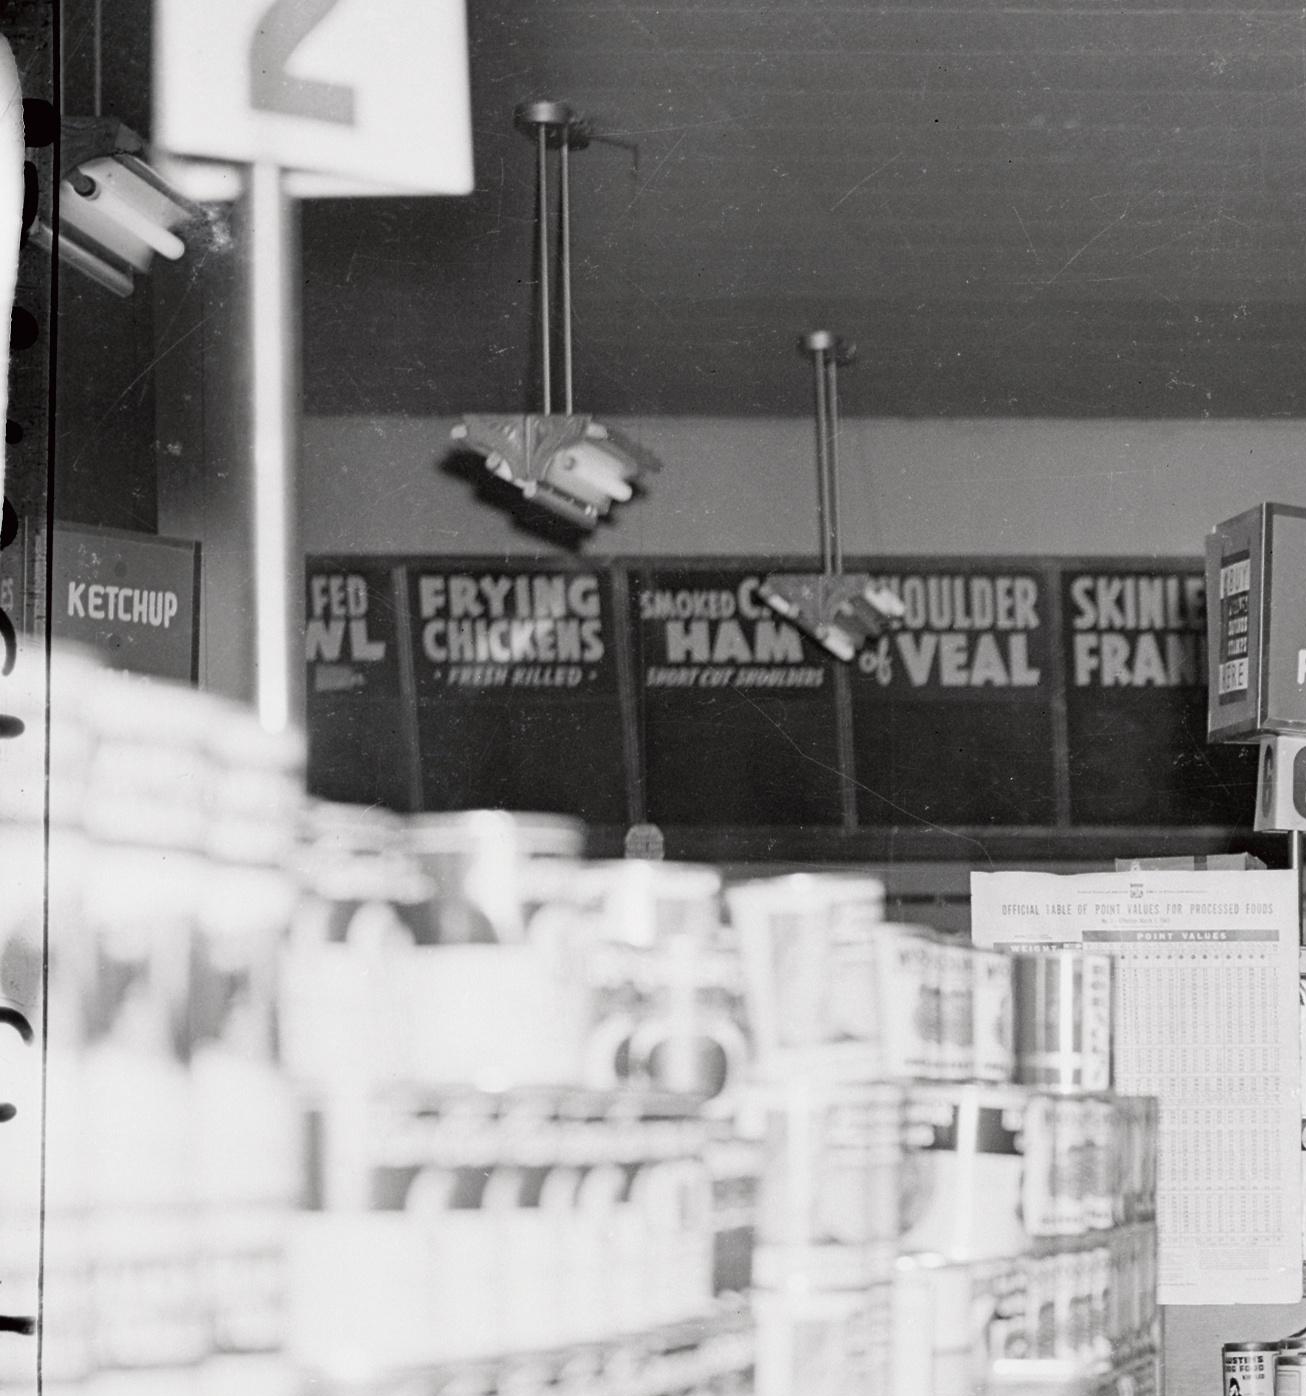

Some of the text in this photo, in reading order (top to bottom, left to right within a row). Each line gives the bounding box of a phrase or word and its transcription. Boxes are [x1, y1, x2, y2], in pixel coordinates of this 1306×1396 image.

[66, 580, 179, 630] KETCHUP
[311, 575, 367, 617] FED
[419, 575, 600, 619] FRYING
[639, 590, 735, 620] SMOKED
[868, 576, 1040, 630] OULDER
[422, 619, 604, 663] CHICKENS
[667, 621, 804, 663] HAM
[859, 633, 1041, 687] of VEAL
[510, 665, 582, 687] KILLED
[1001, 903, 1274, 915] OFFICIAL TABLE OF POINT VALUES FOR PROCESSED FOODS
[1010, 944, 1057, 953] WEIGHT
[1137, 932, 1227, 940] POINT VALUES
[1240, 1364, 1264, 1372] FOD
